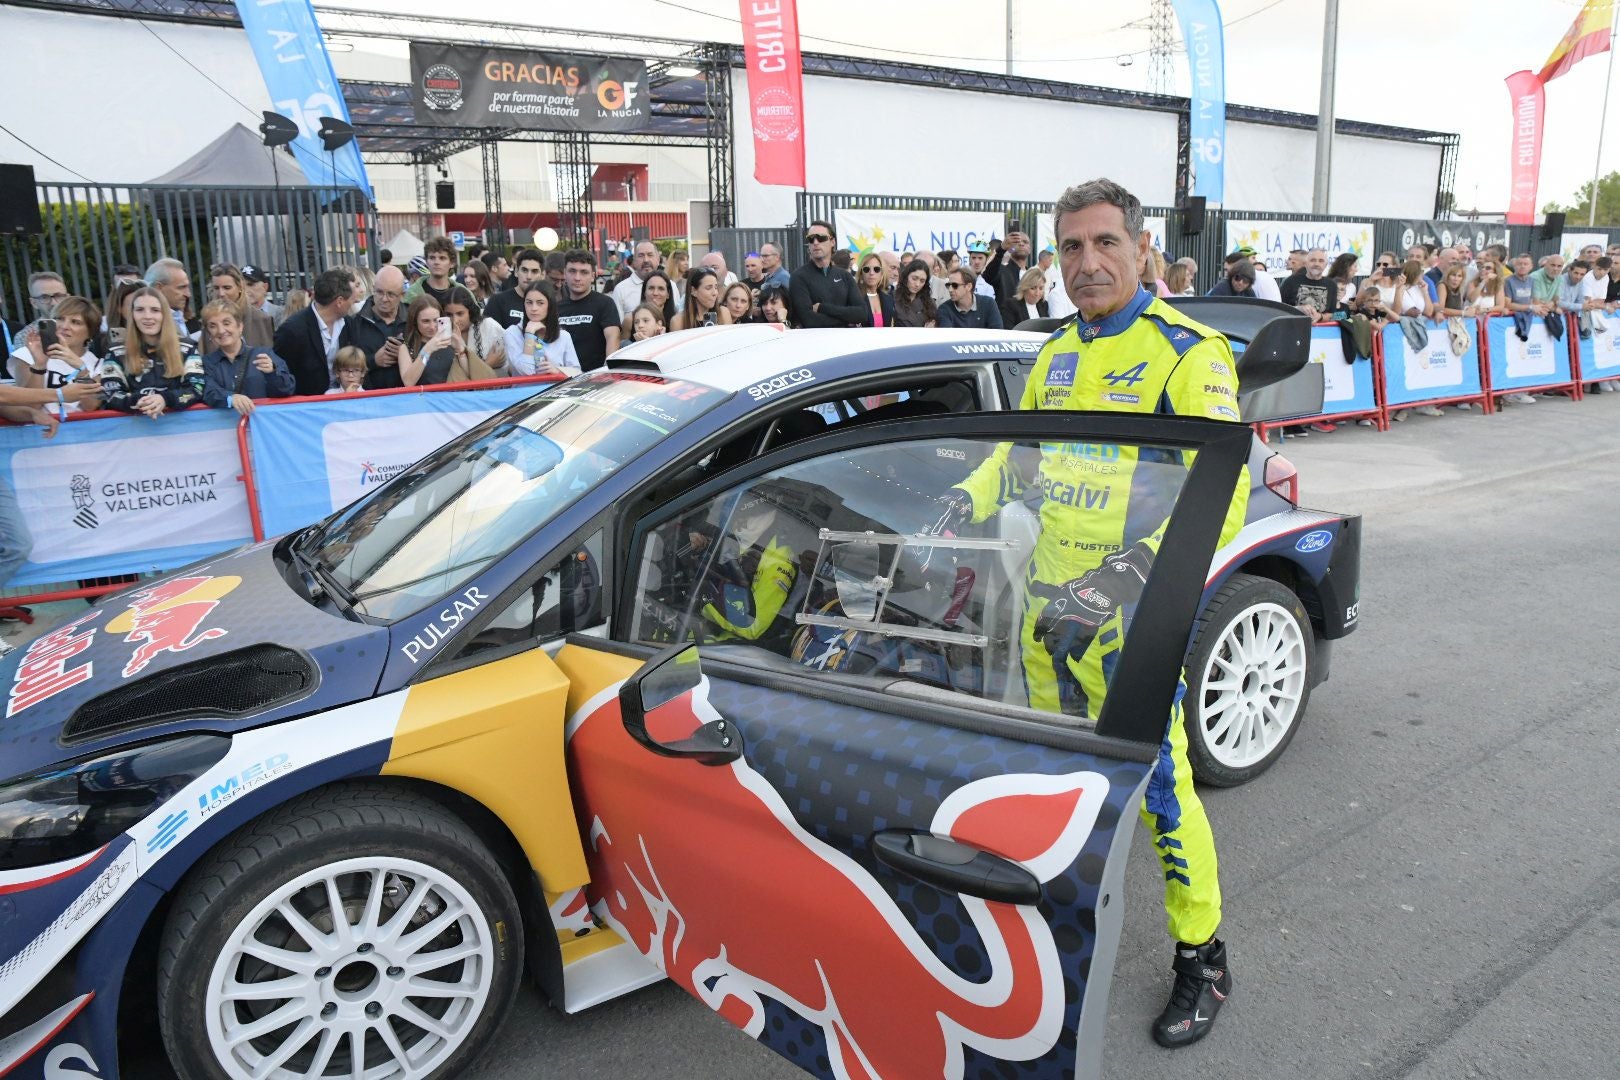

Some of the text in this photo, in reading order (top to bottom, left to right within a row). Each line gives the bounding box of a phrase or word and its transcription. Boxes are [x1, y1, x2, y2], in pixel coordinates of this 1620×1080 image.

[485, 61, 580, 87] GRACIAS
[493, 91, 574, 108] por formar parte
[597, 80, 638, 110] GF
[489, 102, 579, 117] de nuestra historia
[598, 109, 608, 117] LA
[893, 231, 916, 251] LA
[1266, 233, 1282, 252] LA
[748, 368, 815, 398] sparco
[1050, 369, 1071, 380] ECYC
[1048, 387, 1071, 398] Qualitas
[936, 448, 966, 458] sparco
[102, 473, 216, 497] GENERALITAT
[106, 489, 217, 512] VALENCIANA
[1074, 542, 1121, 553] FUSTER
[1301, 533, 1326, 550] Ford
[401, 587, 489, 664] PULSAR
[199, 753, 289, 809] IMED
[201, 762, 294, 817] HOSPITALES
